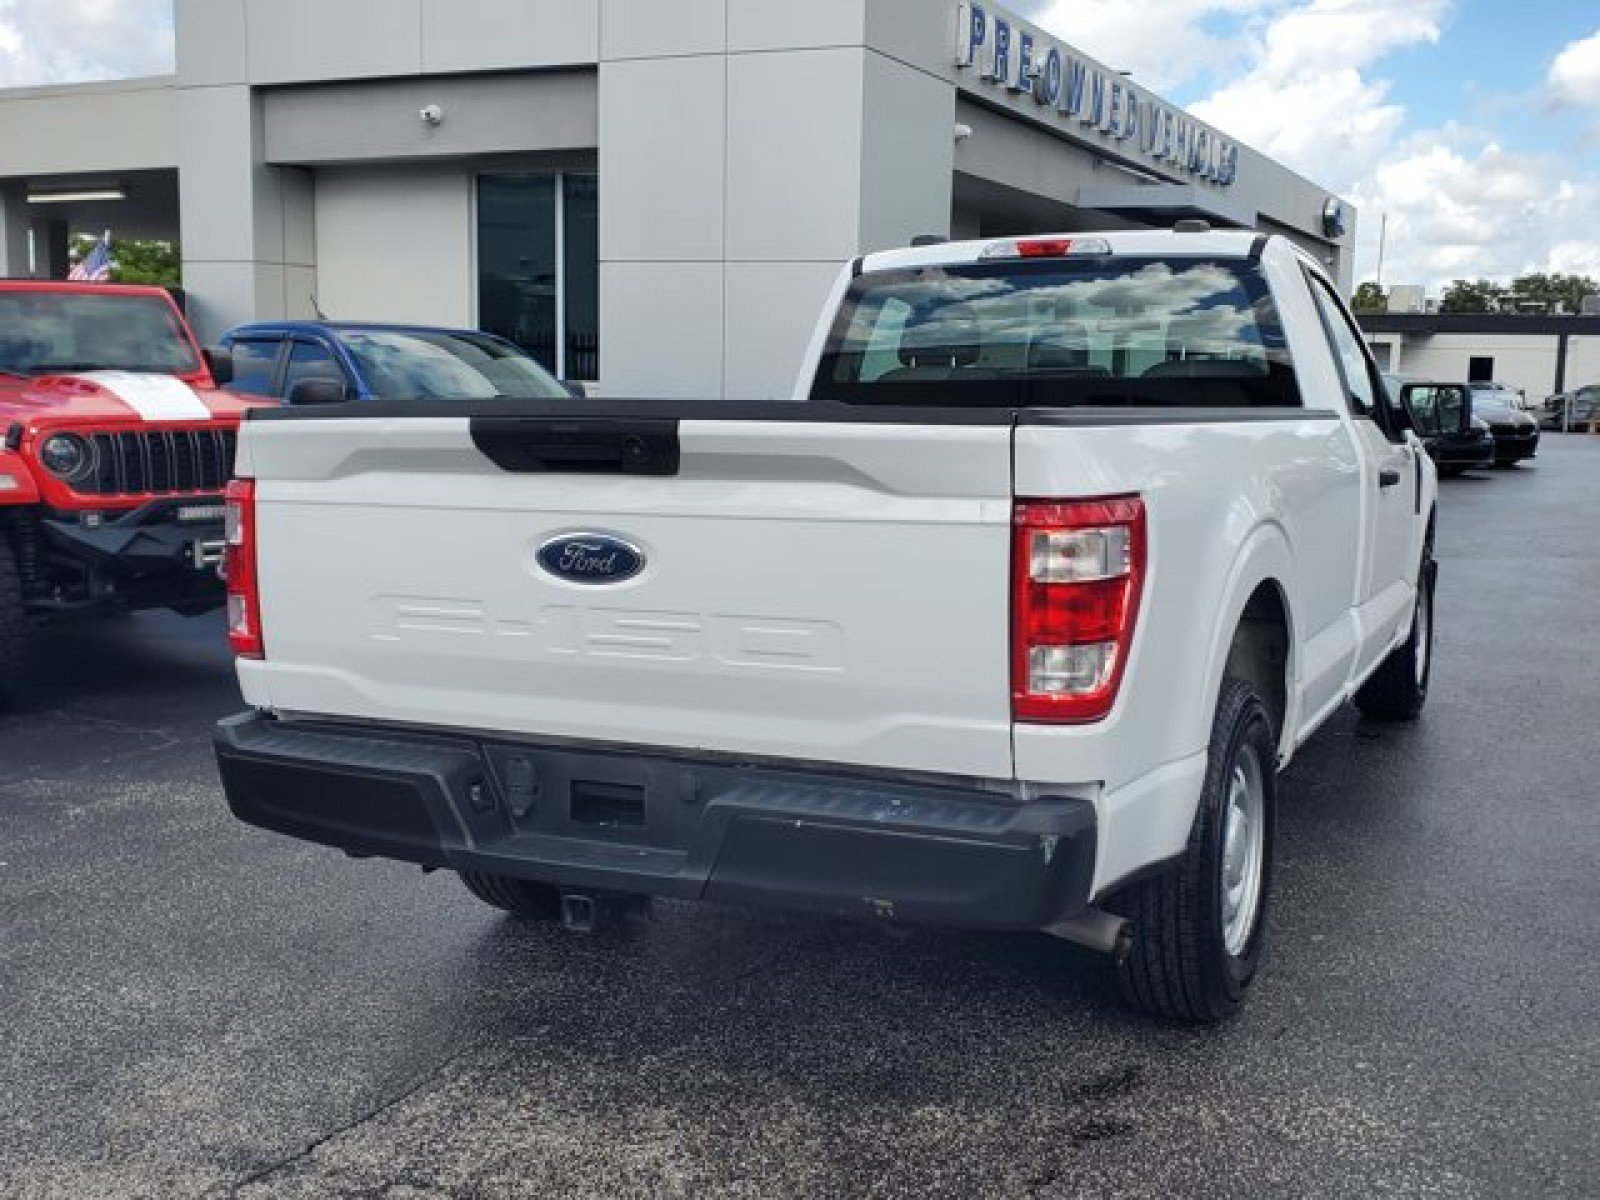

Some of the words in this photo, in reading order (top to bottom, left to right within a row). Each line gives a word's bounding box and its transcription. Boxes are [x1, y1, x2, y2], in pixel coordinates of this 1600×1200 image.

[959, 2, 1137, 139] PRE-OWNED
[560, 542, 616, 573] Ford
[371, 593, 845, 673] F-150
